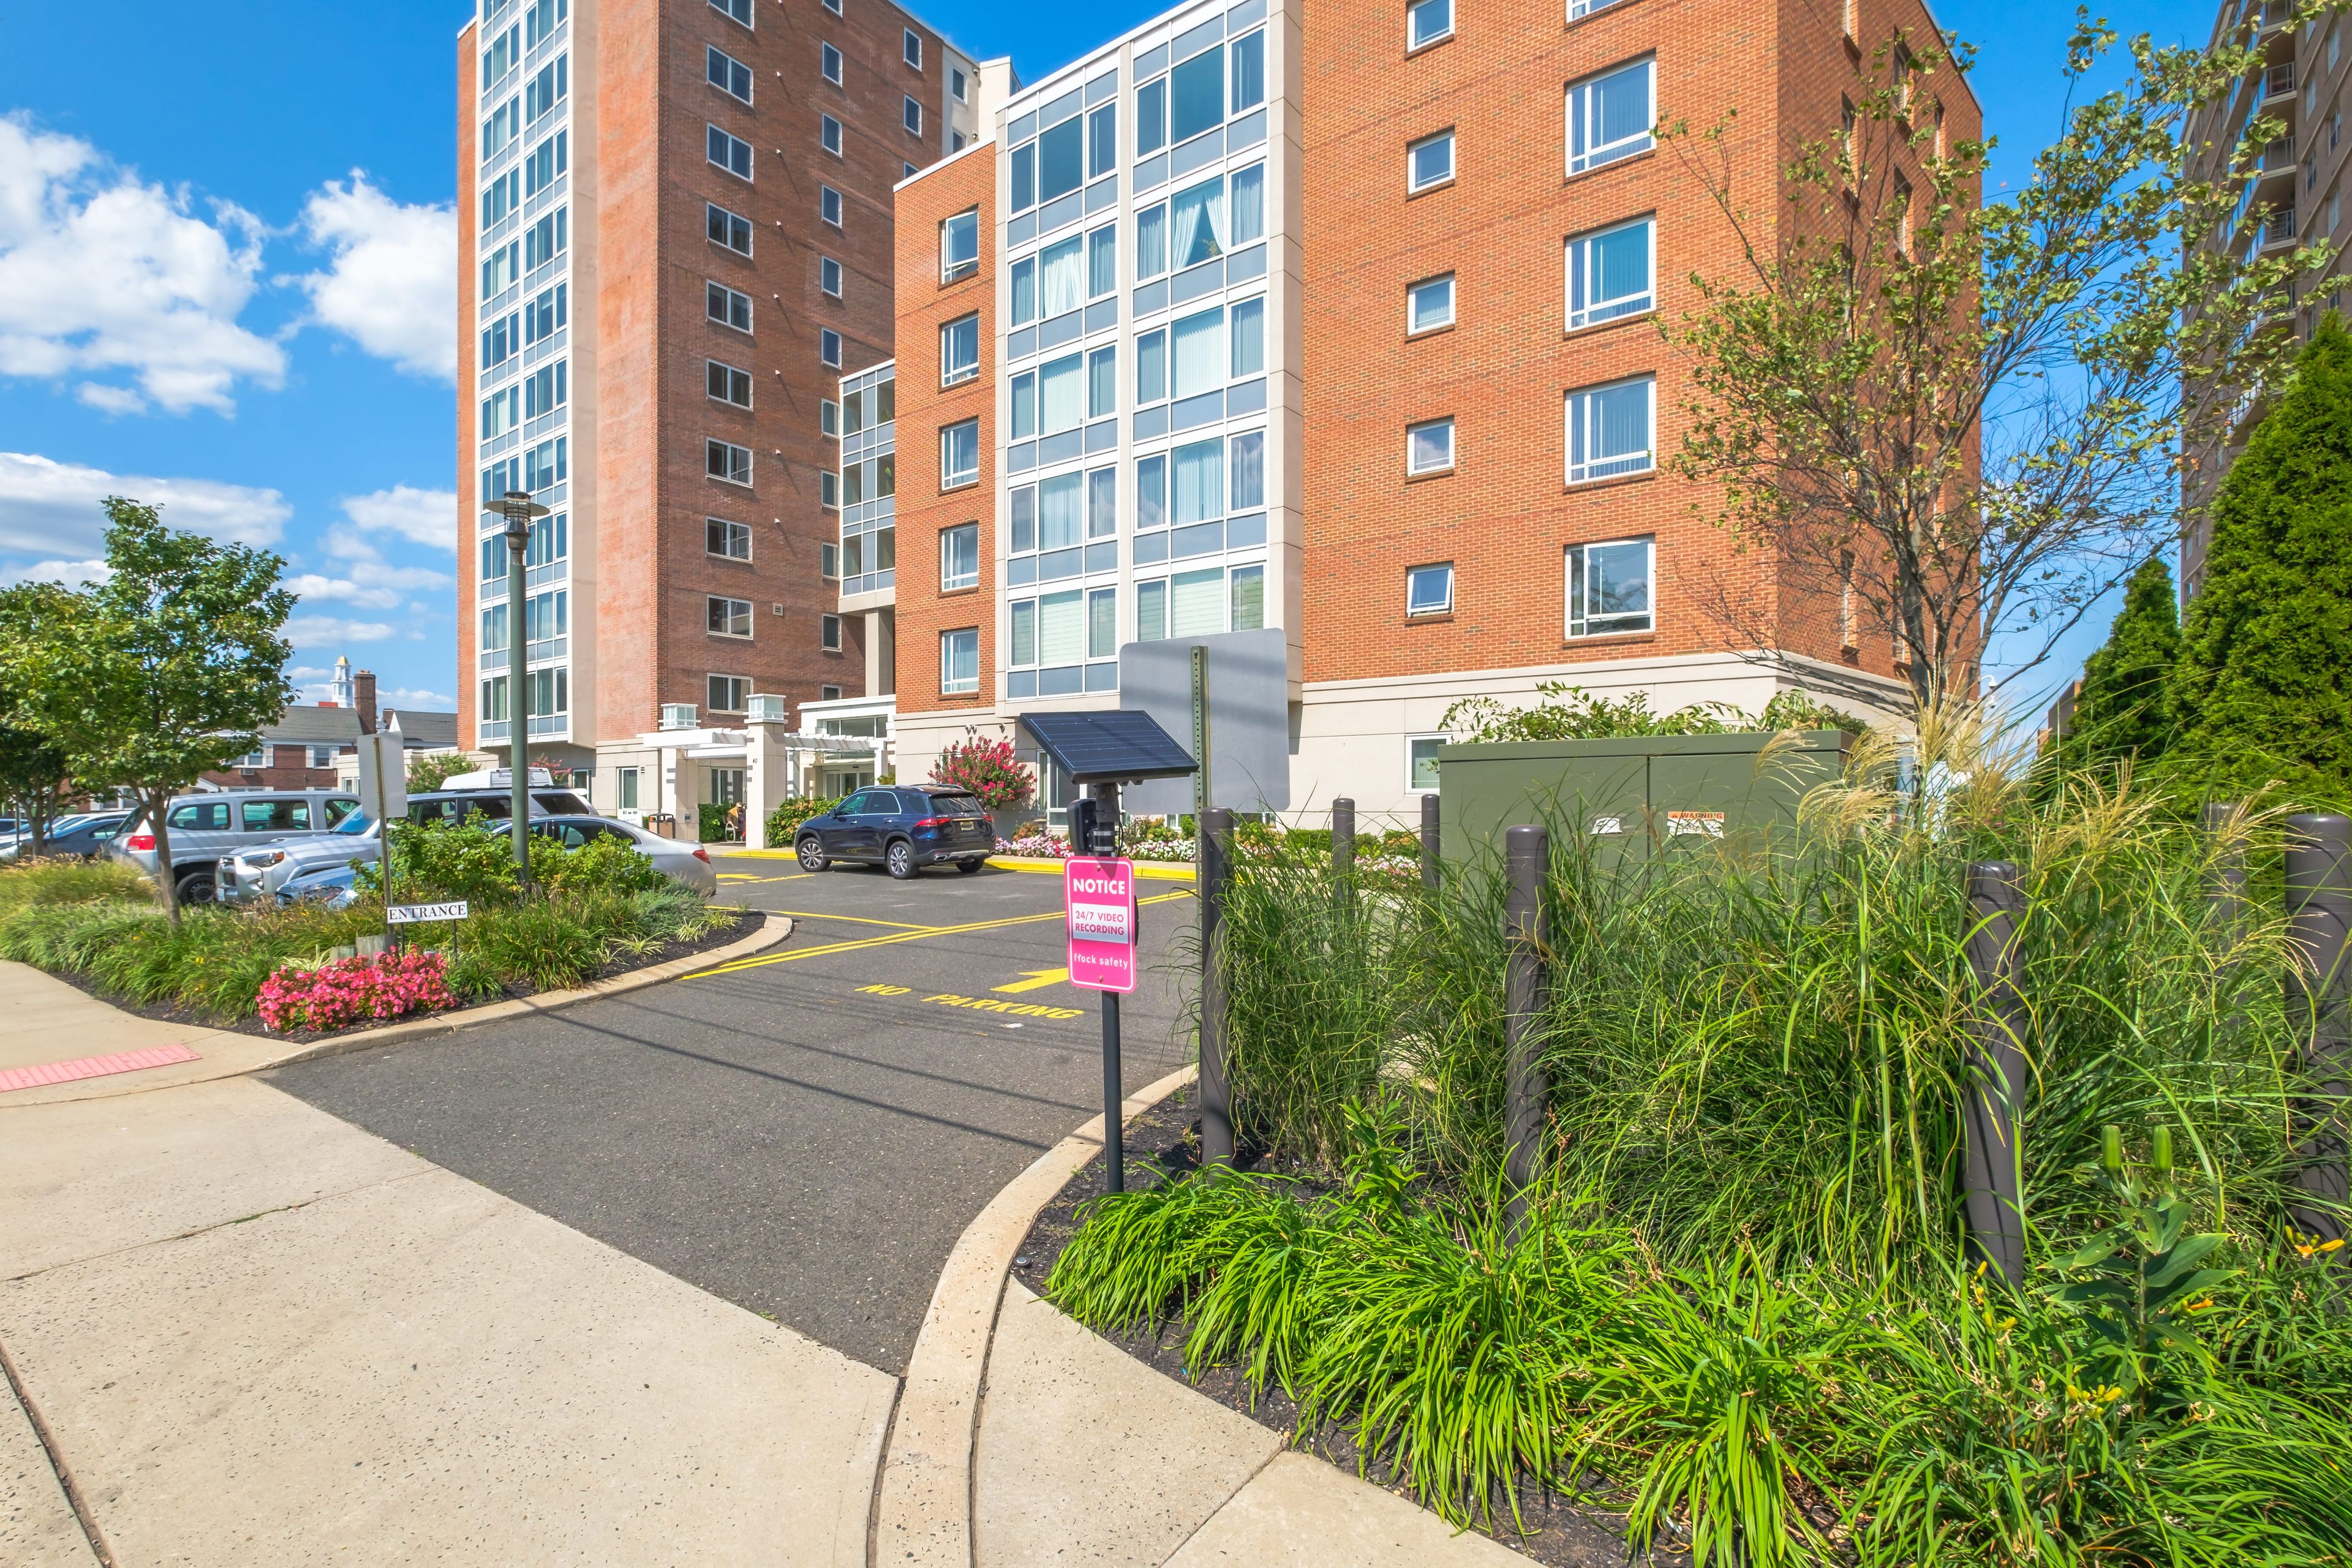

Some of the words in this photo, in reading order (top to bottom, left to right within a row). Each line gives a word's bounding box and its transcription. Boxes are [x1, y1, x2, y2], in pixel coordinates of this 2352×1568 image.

[1073, 878, 1125, 894] NOTICE
[389, 905, 466, 920] ENTRANCE
[1076, 911, 1094, 920] 24/7
[1098, 913, 1124, 922] VIDEO
[1075, 923, 1125, 935] RECORDING
[1099, 957, 1128, 970] safety
[855, 984, 912, 995] NO
[921, 993, 1084, 1019] PARKING
